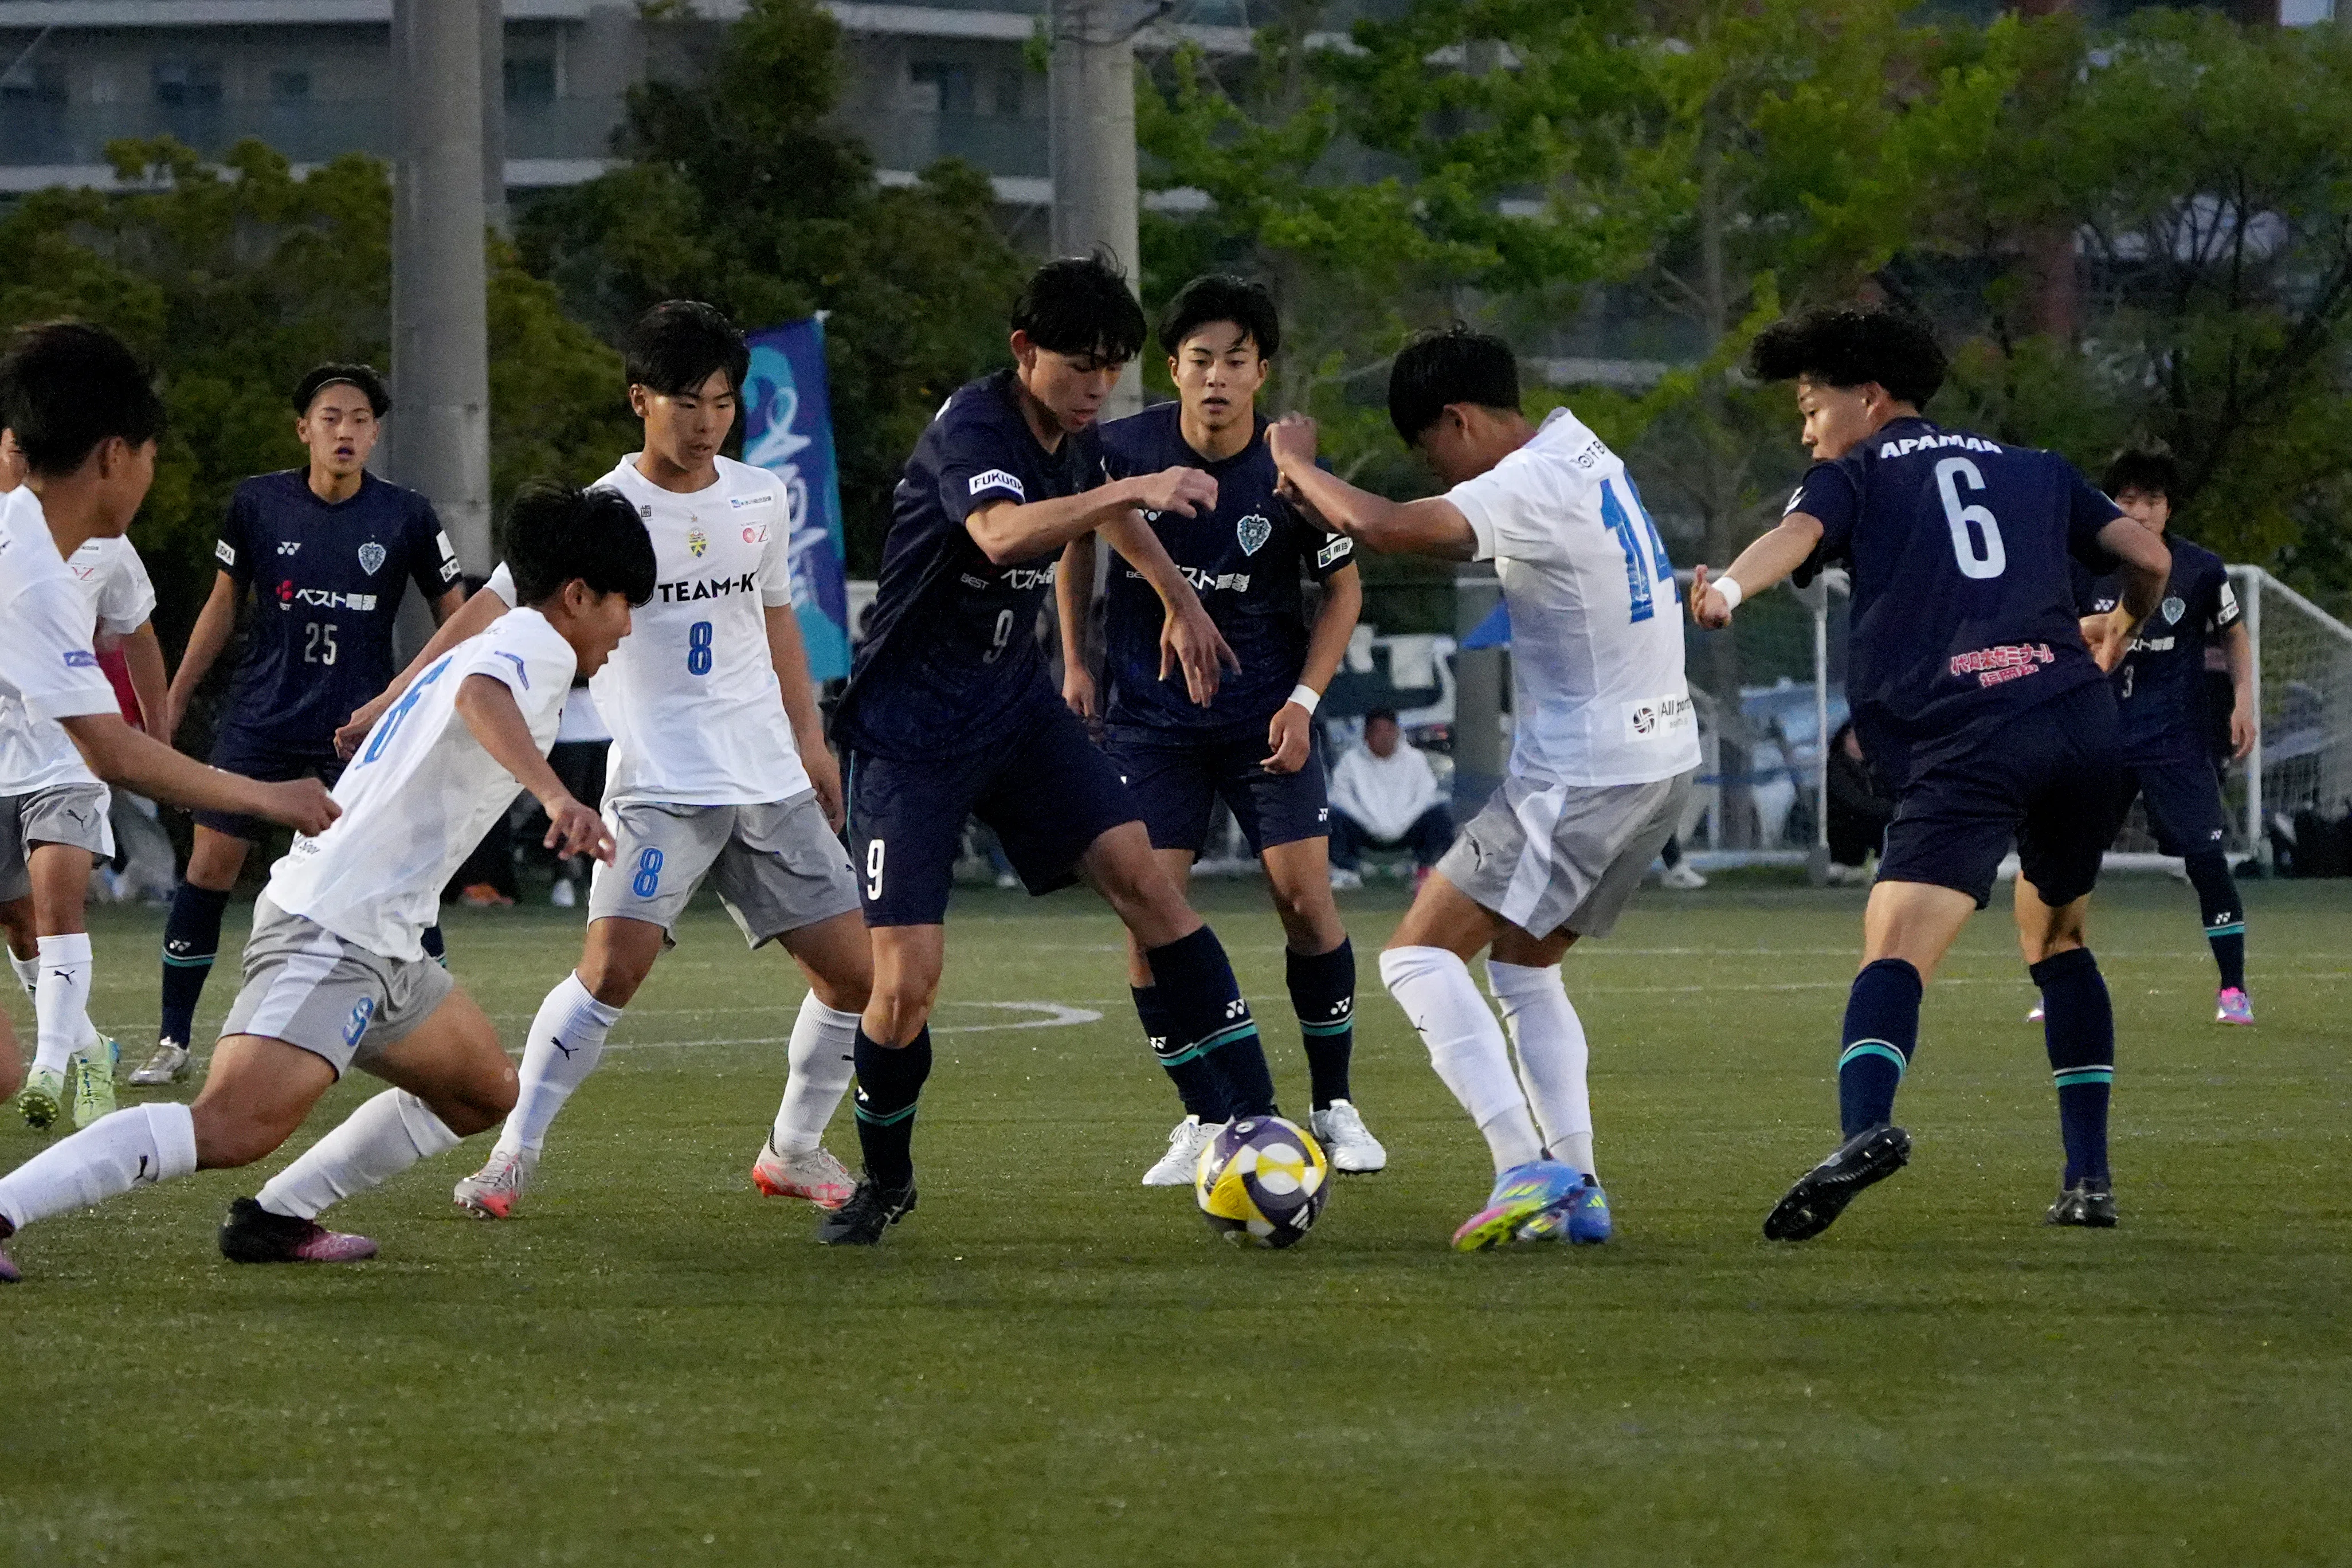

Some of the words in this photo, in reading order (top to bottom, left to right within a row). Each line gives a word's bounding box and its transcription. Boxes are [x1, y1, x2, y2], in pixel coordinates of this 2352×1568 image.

[1935, 457, 2006, 579] 6
[960, 572, 989, 590] BEST
[304, 621, 338, 665] 25
[687, 621, 713, 676] 8
[982, 608, 1014, 664] 9
[2122, 664, 2135, 699] 3
[632, 847, 664, 897] 8
[867, 838, 885, 901] 9
